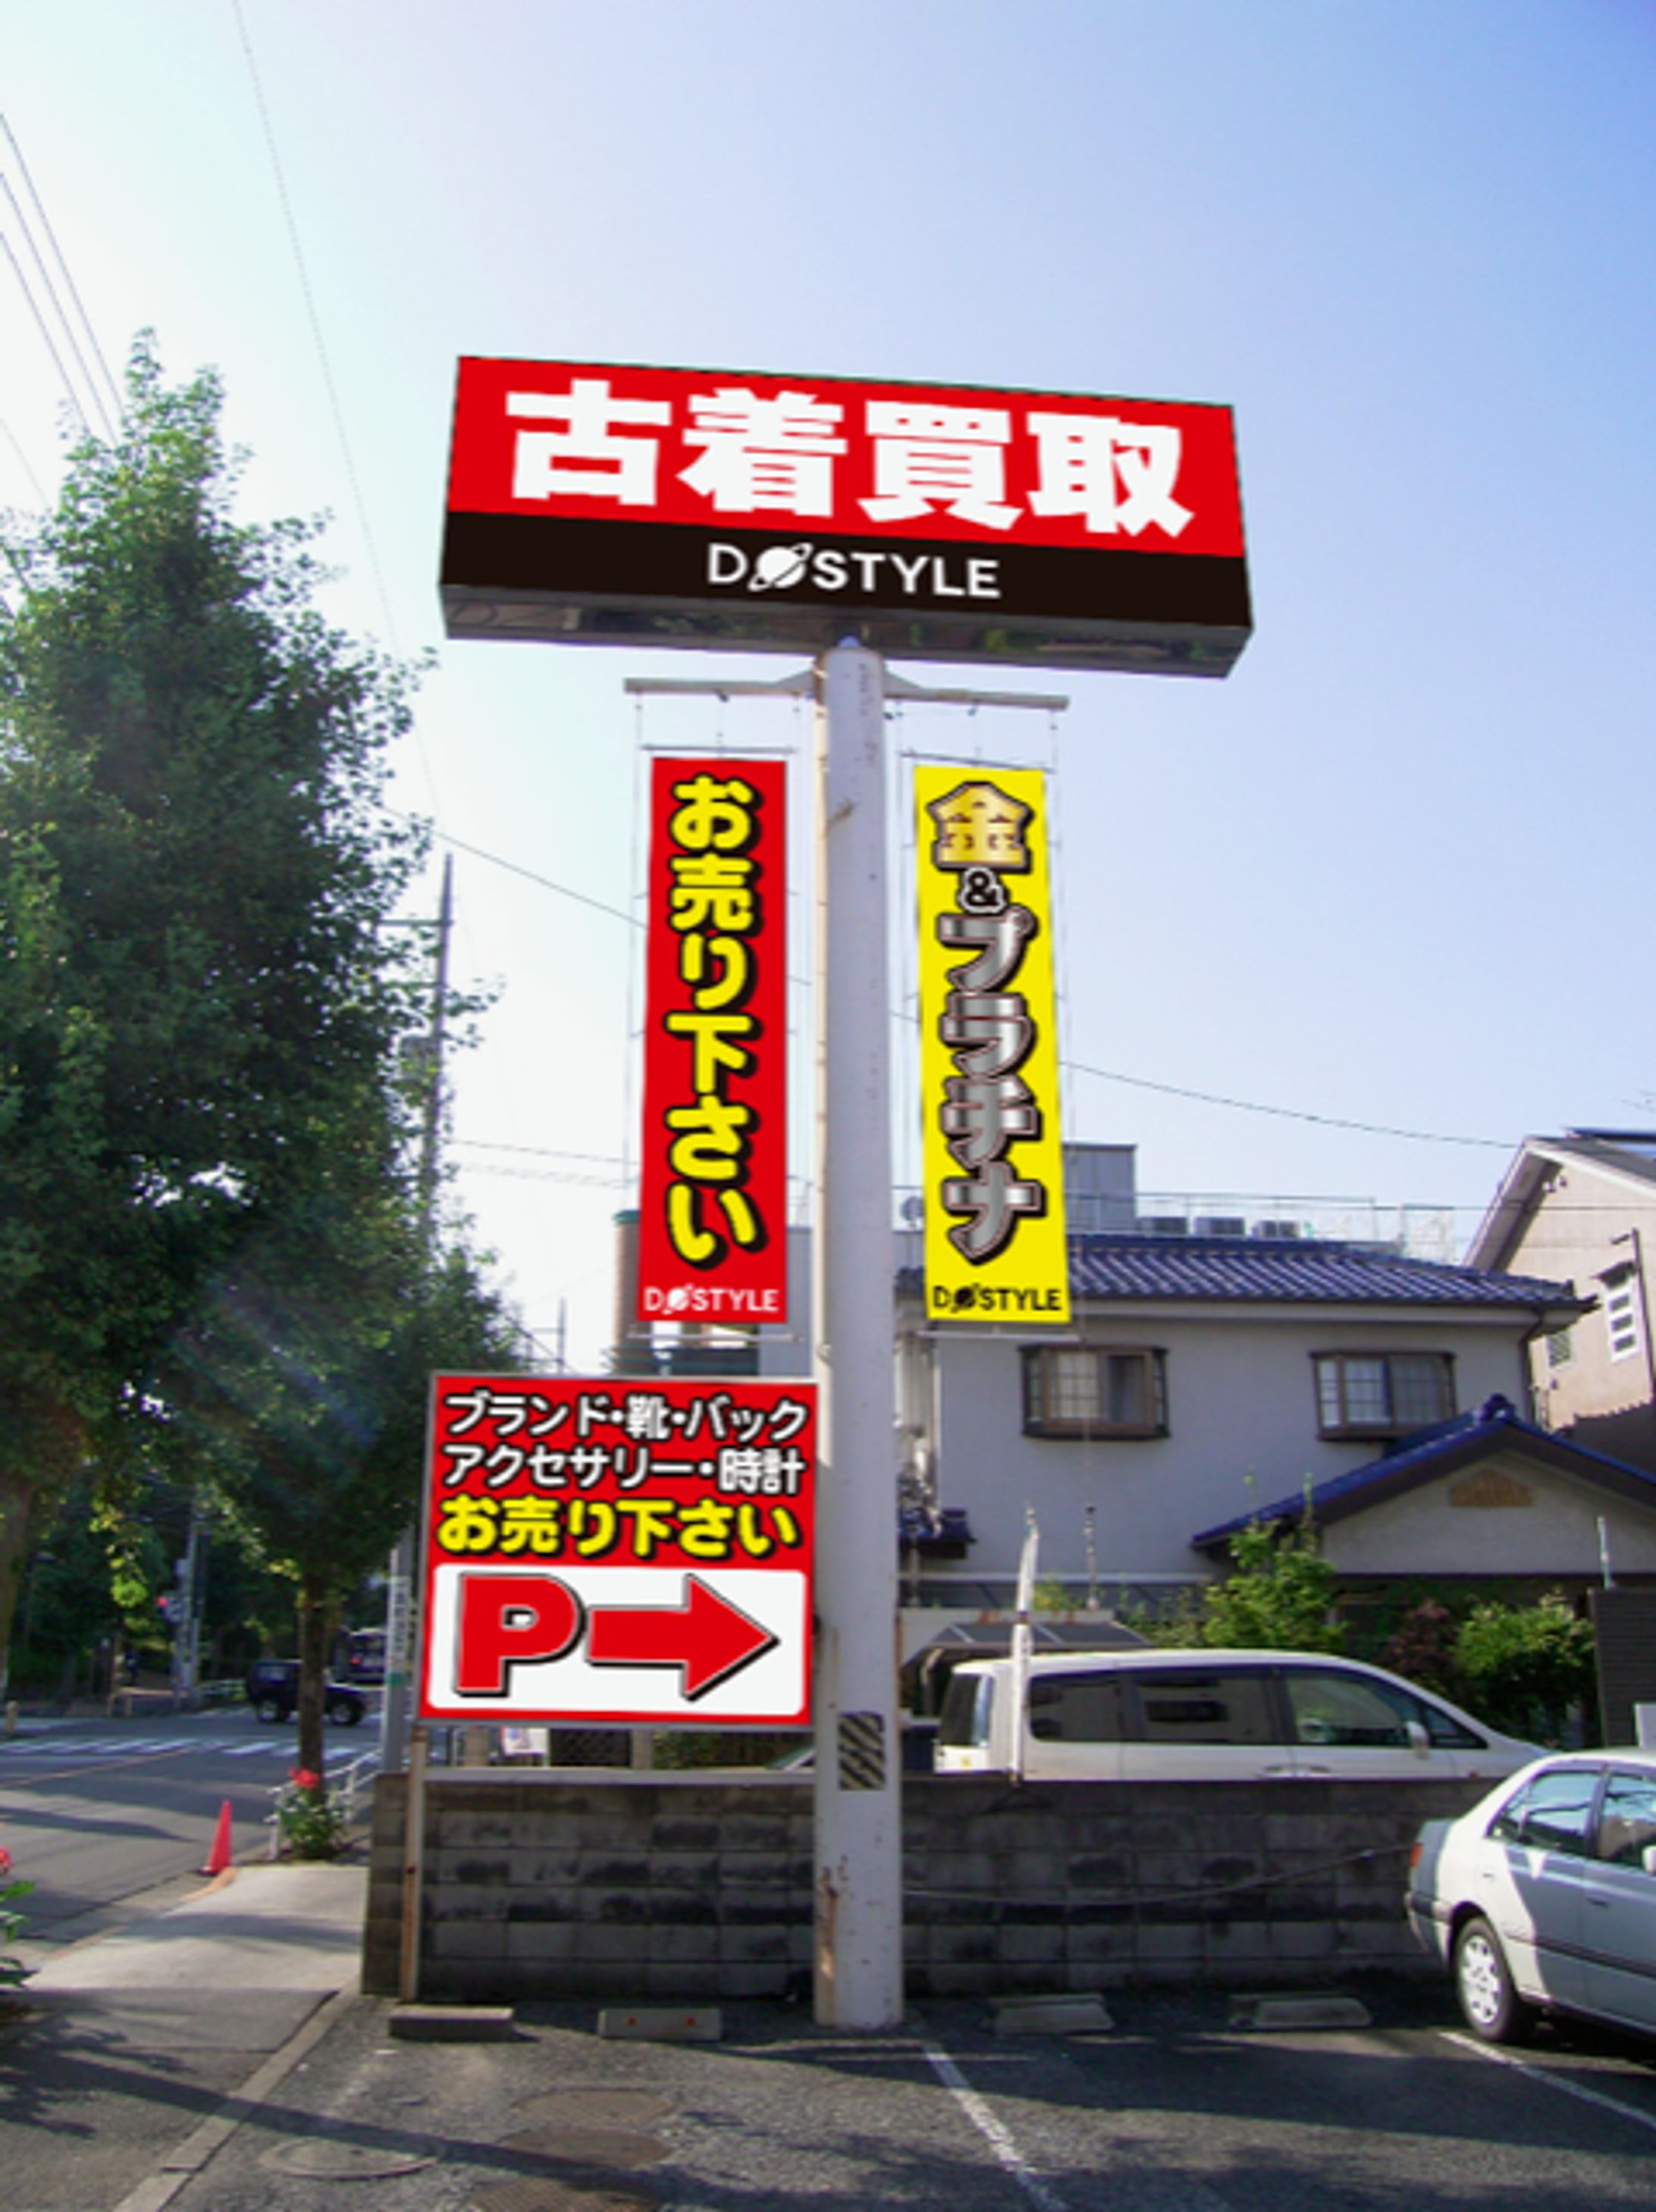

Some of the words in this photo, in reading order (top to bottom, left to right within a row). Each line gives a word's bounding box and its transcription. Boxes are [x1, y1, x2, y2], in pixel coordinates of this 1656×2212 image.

[504, 378, 1194, 538] 古着買取
[665, 774, 767, 1267] お売り下さい
[437, 1493, 798, 1558] お売り下さい
[443, 1443, 806, 1494] アクセサリー・時計
[454, 1572, 585, 1697] P
